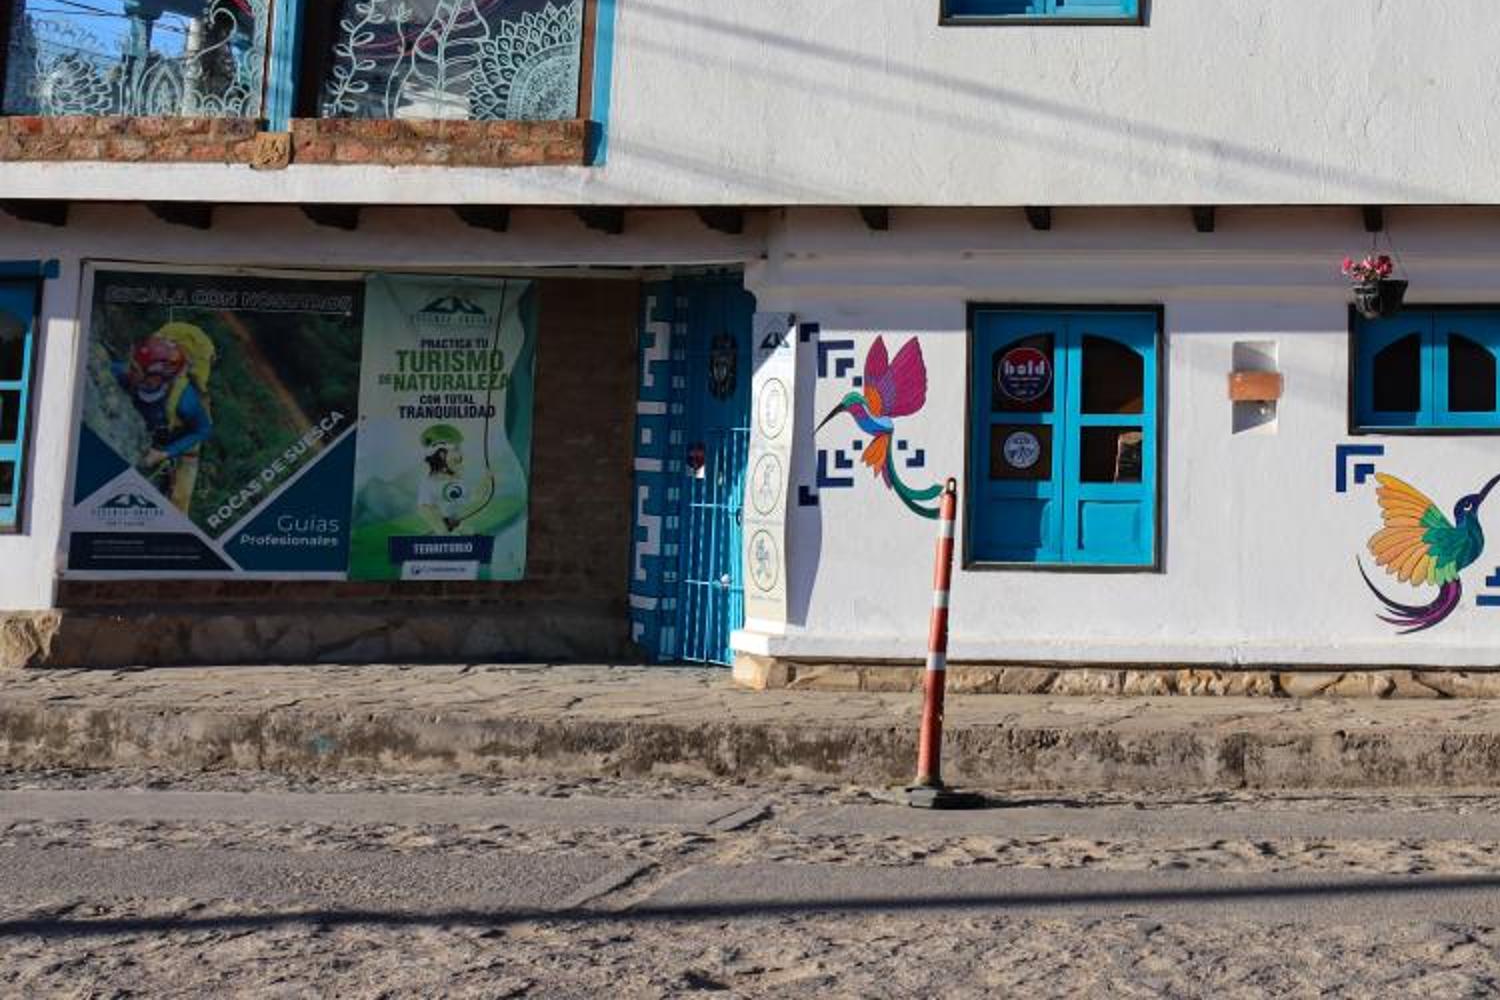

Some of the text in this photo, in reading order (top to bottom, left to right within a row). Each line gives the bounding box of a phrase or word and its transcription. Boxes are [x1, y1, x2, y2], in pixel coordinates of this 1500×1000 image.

[420, 338, 489, 349] PRACTICA TU
[396, 350, 504, 373] TURISMO
[393, 374, 511, 392] NATURALEZA
[419, 394, 475, 405] CON TOTAL
[398, 406, 495, 419] TRANQUILIDAD
[207, 410, 346, 529] ROCAS DE SUESCA
[240, 534, 339, 547] Profesionales
[414, 542, 473, 554] TERRITORIO
